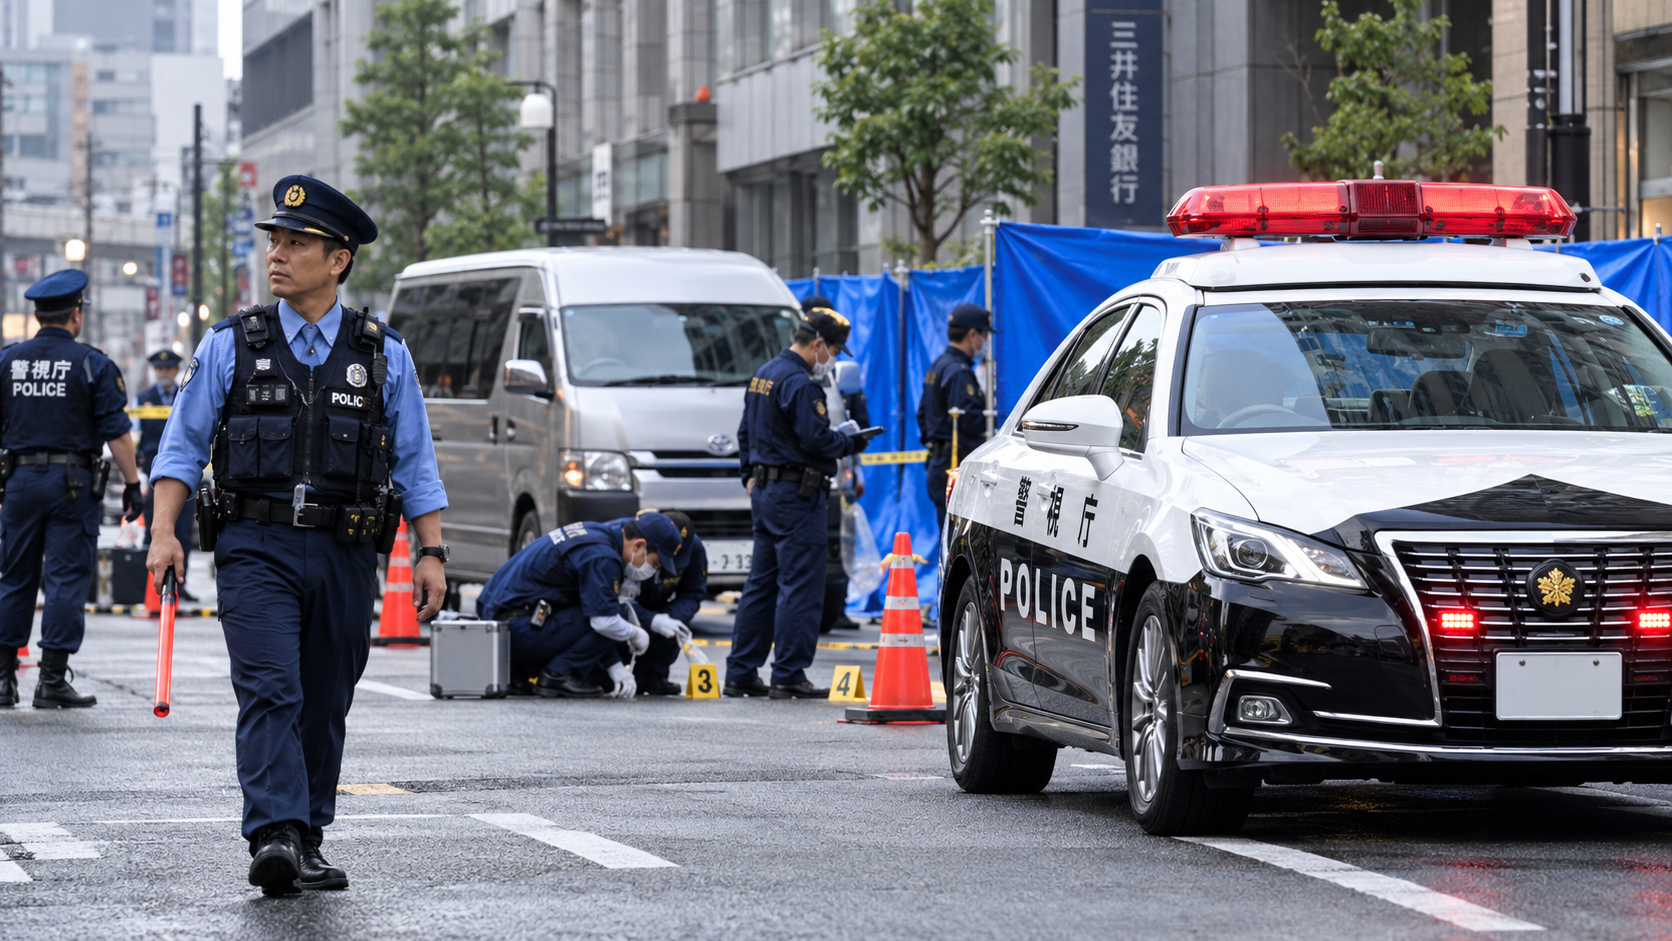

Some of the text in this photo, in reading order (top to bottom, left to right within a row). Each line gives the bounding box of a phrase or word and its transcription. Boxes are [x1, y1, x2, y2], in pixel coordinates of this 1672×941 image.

[1109, 21, 1139, 204] 三井住友銀行
[10, 359, 72, 380] 警視庁
[13, 382, 66, 397] POLICE
[331, 392, 369, 408] POLIC
[1014, 475, 1098, 548] 警視庁
[1000, 557, 1096, 642] POLICE
[698, 669, 712, 693] 3
[836, 671, 851, 696] 4
